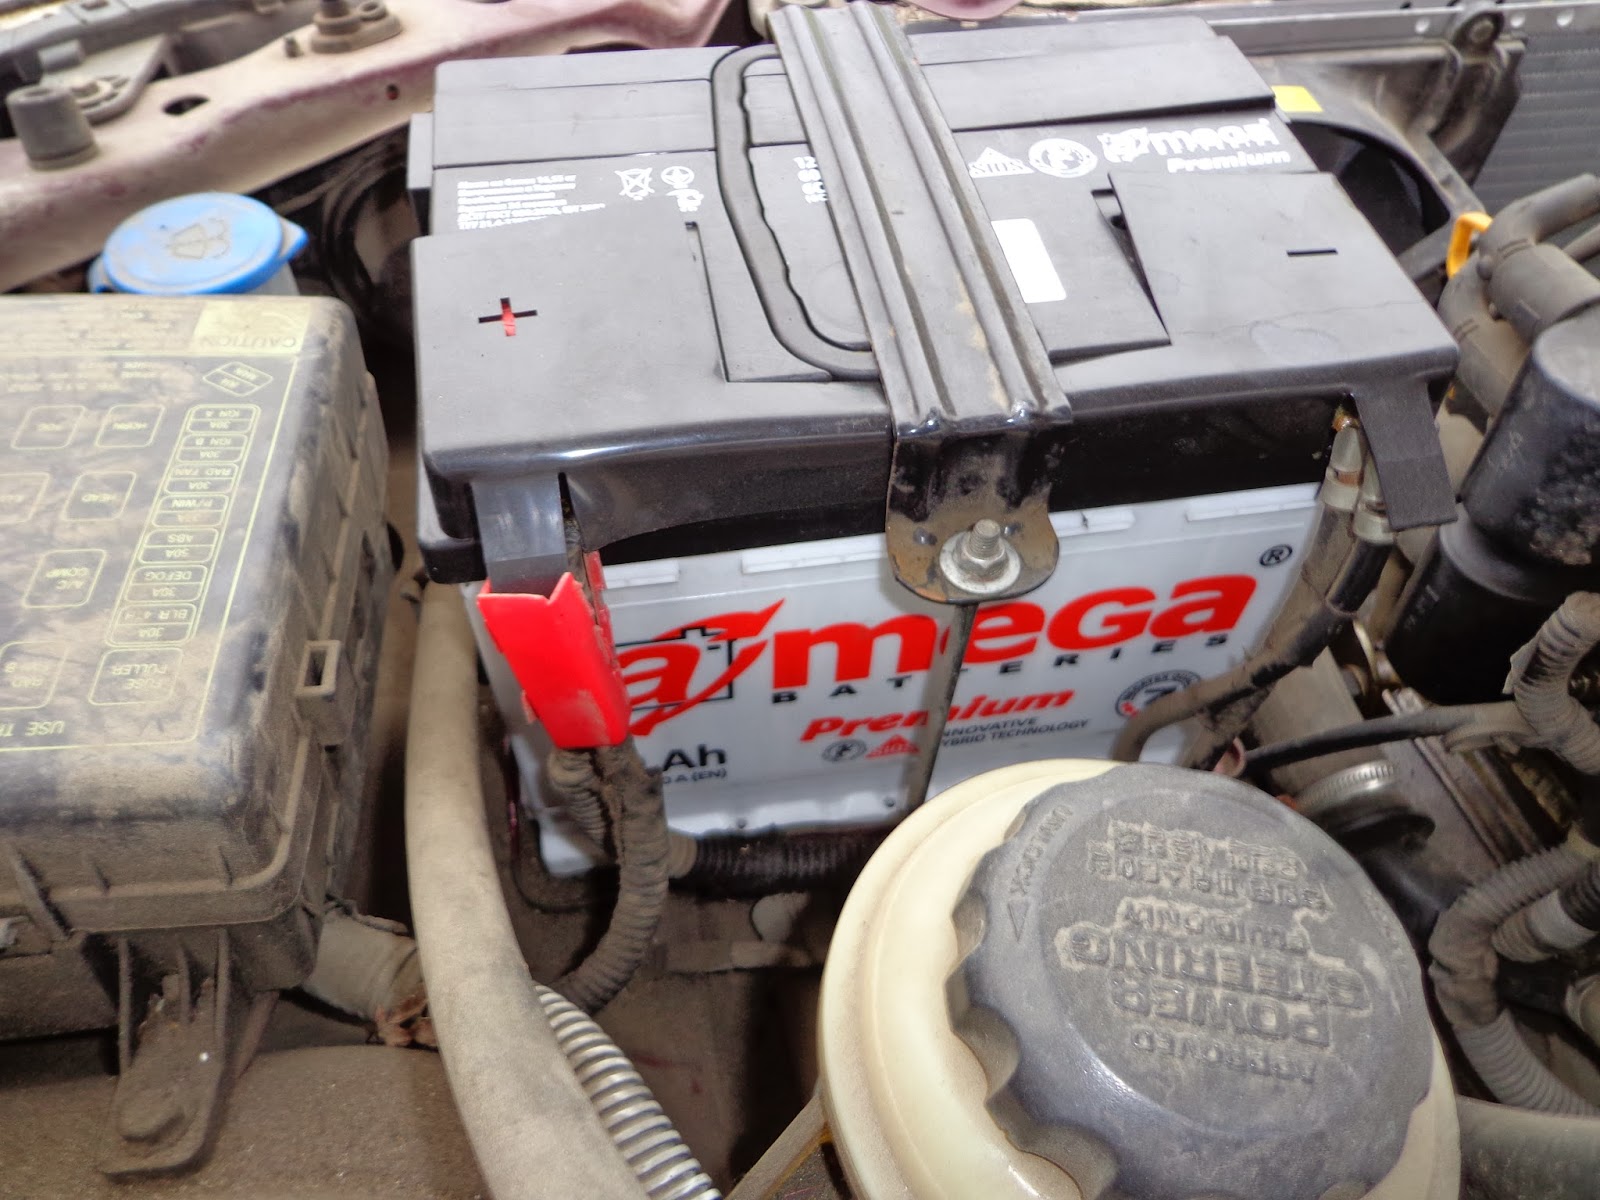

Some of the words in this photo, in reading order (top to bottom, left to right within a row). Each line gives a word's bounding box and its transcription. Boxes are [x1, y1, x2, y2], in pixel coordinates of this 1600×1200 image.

[167, 534, 193, 543] ABS
[144, 571, 192, 581] DEFOG
[112, 663, 168, 676] PULLER
[25, 720, 65, 737] USE
[942, 733, 986, 747] YBRID
[991, 718, 1090, 741] TECHNOLOGY
[662, 744, 727, 772] Ah
[1066, 922, 1371, 1010] STEERING
[1110, 968, 1331, 1048] POWER
